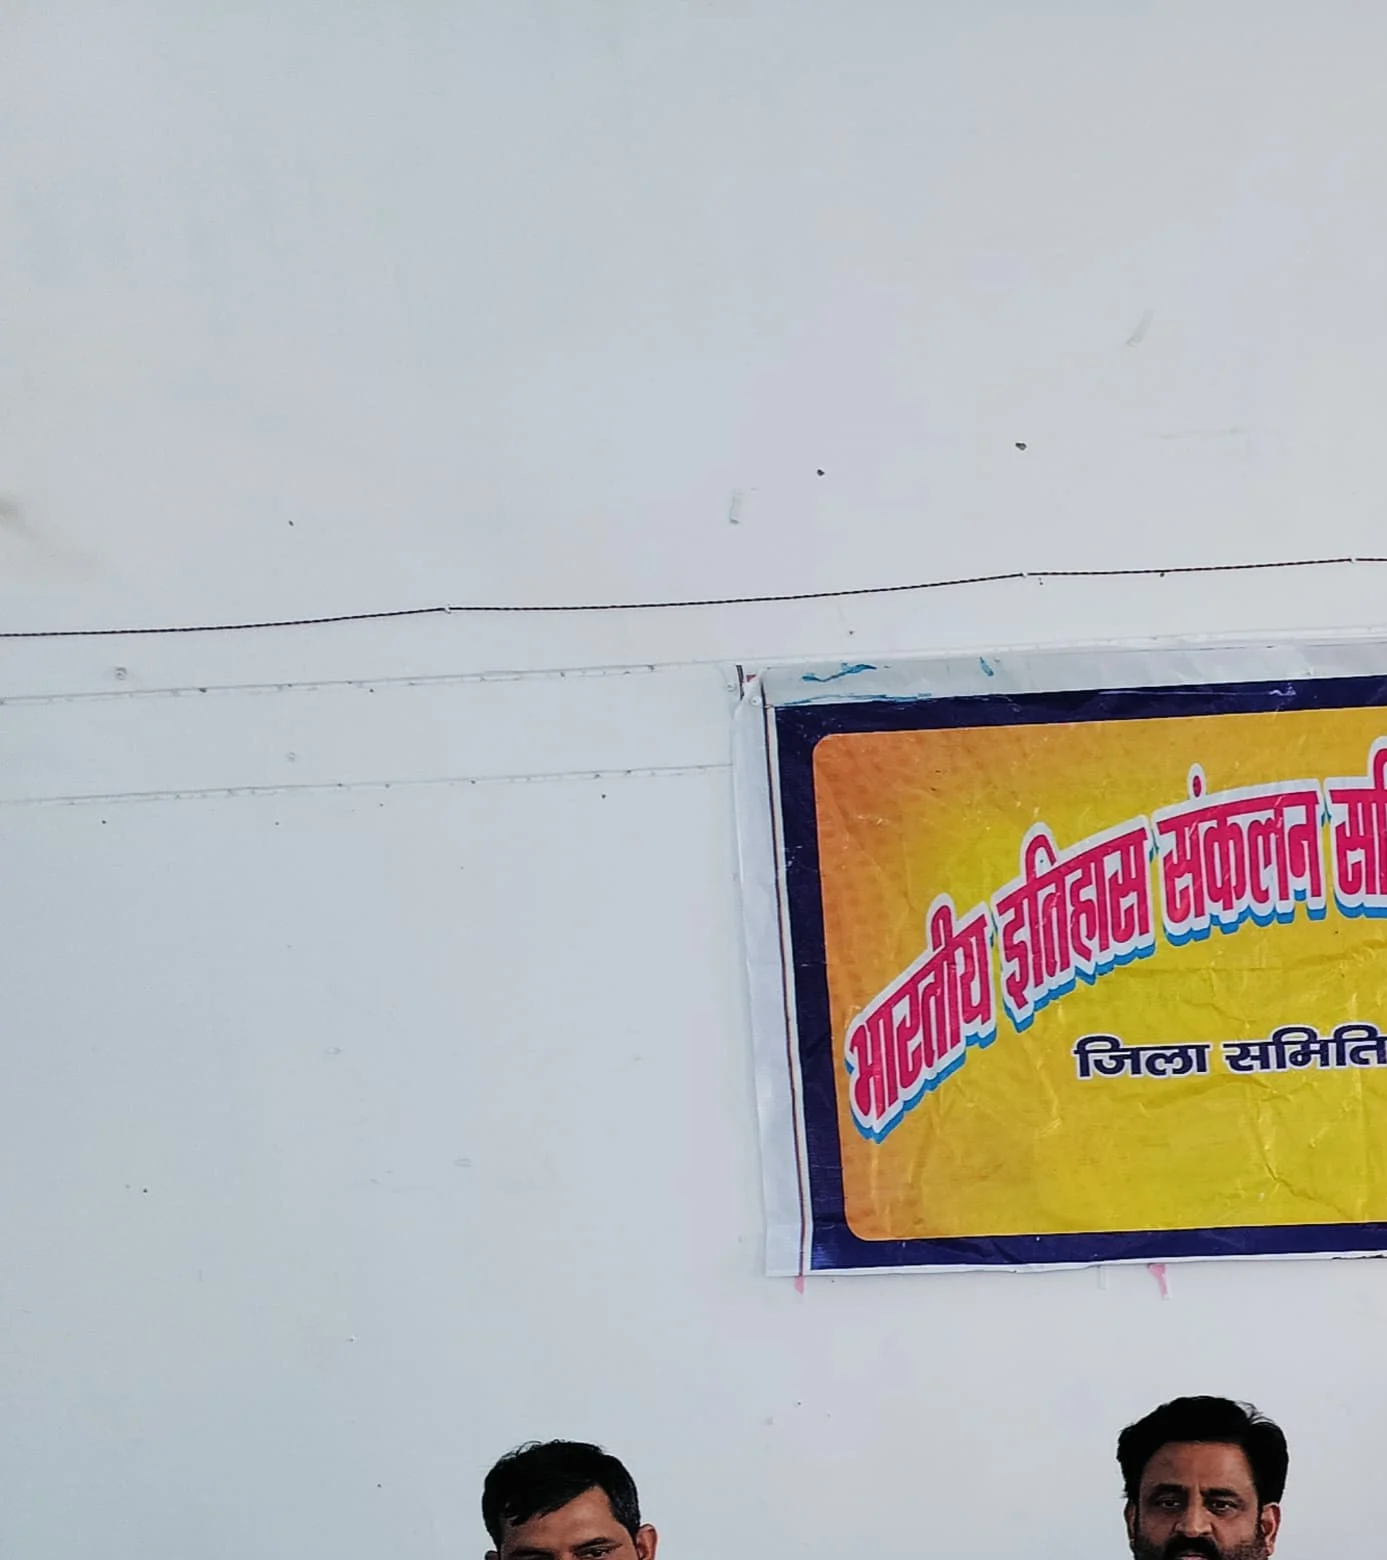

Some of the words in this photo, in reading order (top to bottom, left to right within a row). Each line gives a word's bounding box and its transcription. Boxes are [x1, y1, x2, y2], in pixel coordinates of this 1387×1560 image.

[848, 898, 992, 1128] भारतीय
[994, 829, 1154, 1018] इतिहास
[1154, 770, 1324, 930] संकलन
[1073, 1034, 1213, 1078] जिला
